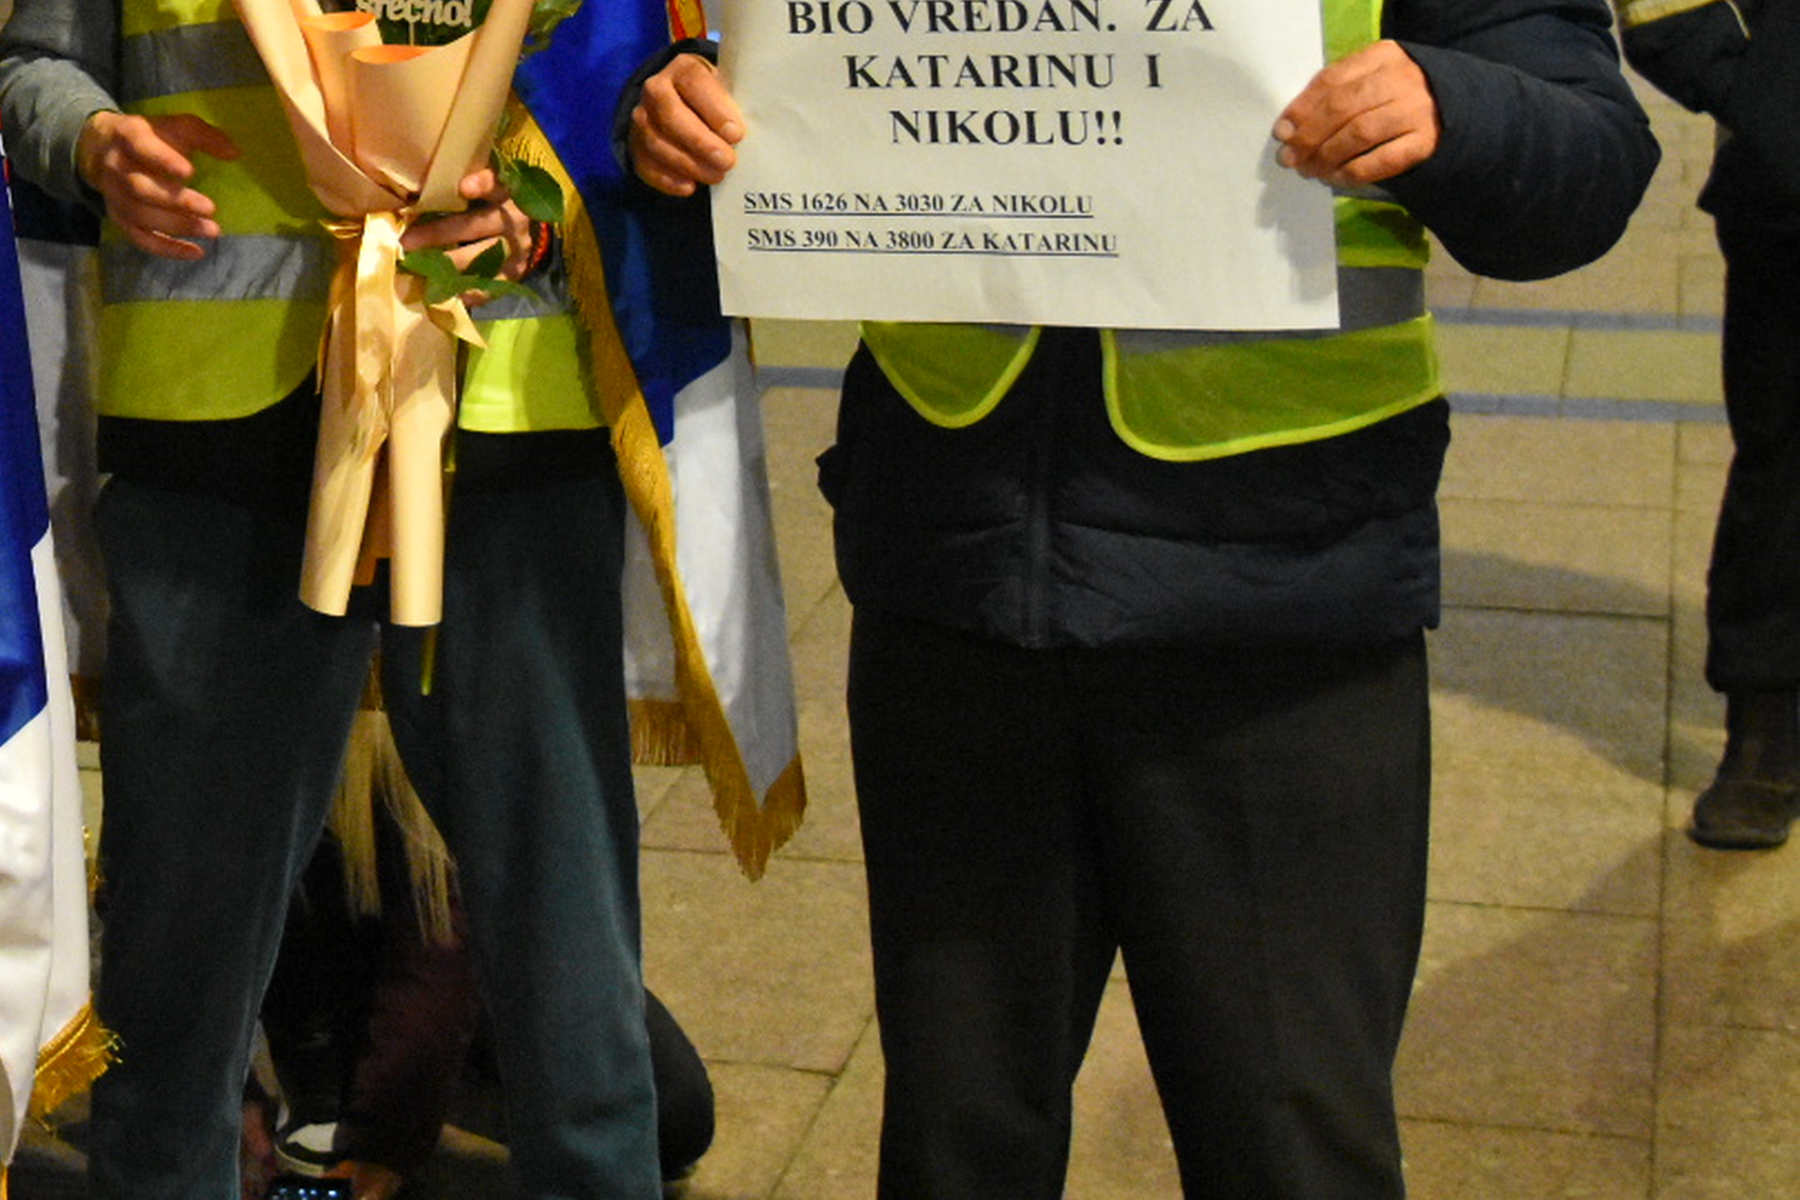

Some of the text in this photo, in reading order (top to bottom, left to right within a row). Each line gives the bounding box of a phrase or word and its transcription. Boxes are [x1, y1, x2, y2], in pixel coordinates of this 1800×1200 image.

[787, 0, 874, 35] BIO
[844, 54, 1161, 89] KATARINU I
[889, 110, 1123, 146] NIKOLU!!
[744, 192, 1093, 215] SMS 1626 NA 3030 ZA NIKOLU
[747, 228, 1118, 253] SMS 390 NA 3800 ZA KATARINU
